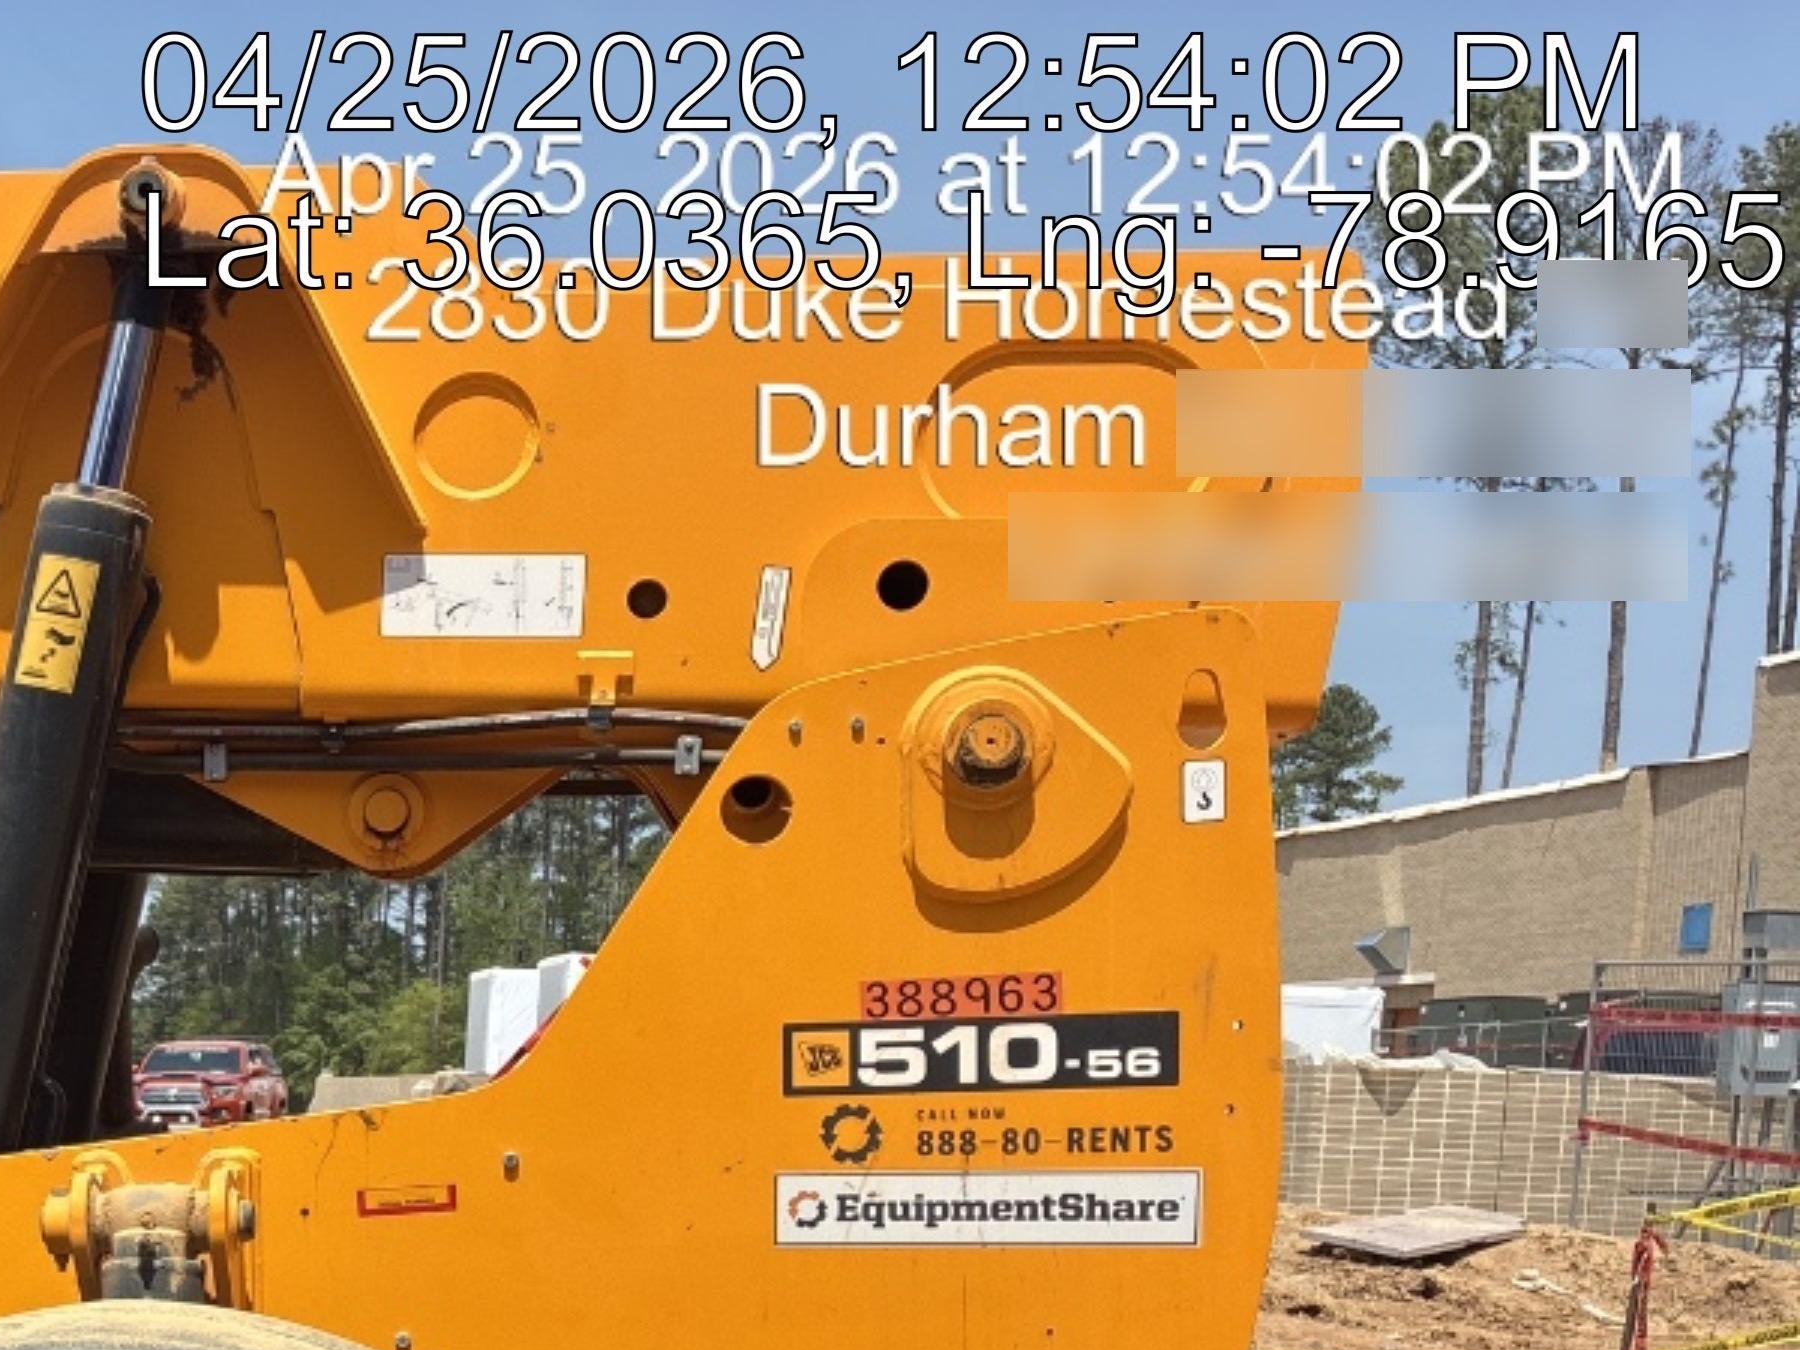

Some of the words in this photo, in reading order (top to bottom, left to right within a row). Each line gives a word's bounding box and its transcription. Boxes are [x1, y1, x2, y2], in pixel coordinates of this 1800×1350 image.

[865, 973, 1059, 1018] 388963
[916, 1109, 959, 1122] CALL
[968, 1107, 1006, 1120] NOW
[916, 1125, 1174, 1157] 888-80-RENTS
[835, 1193, 1181, 1229] EquipmentShare
